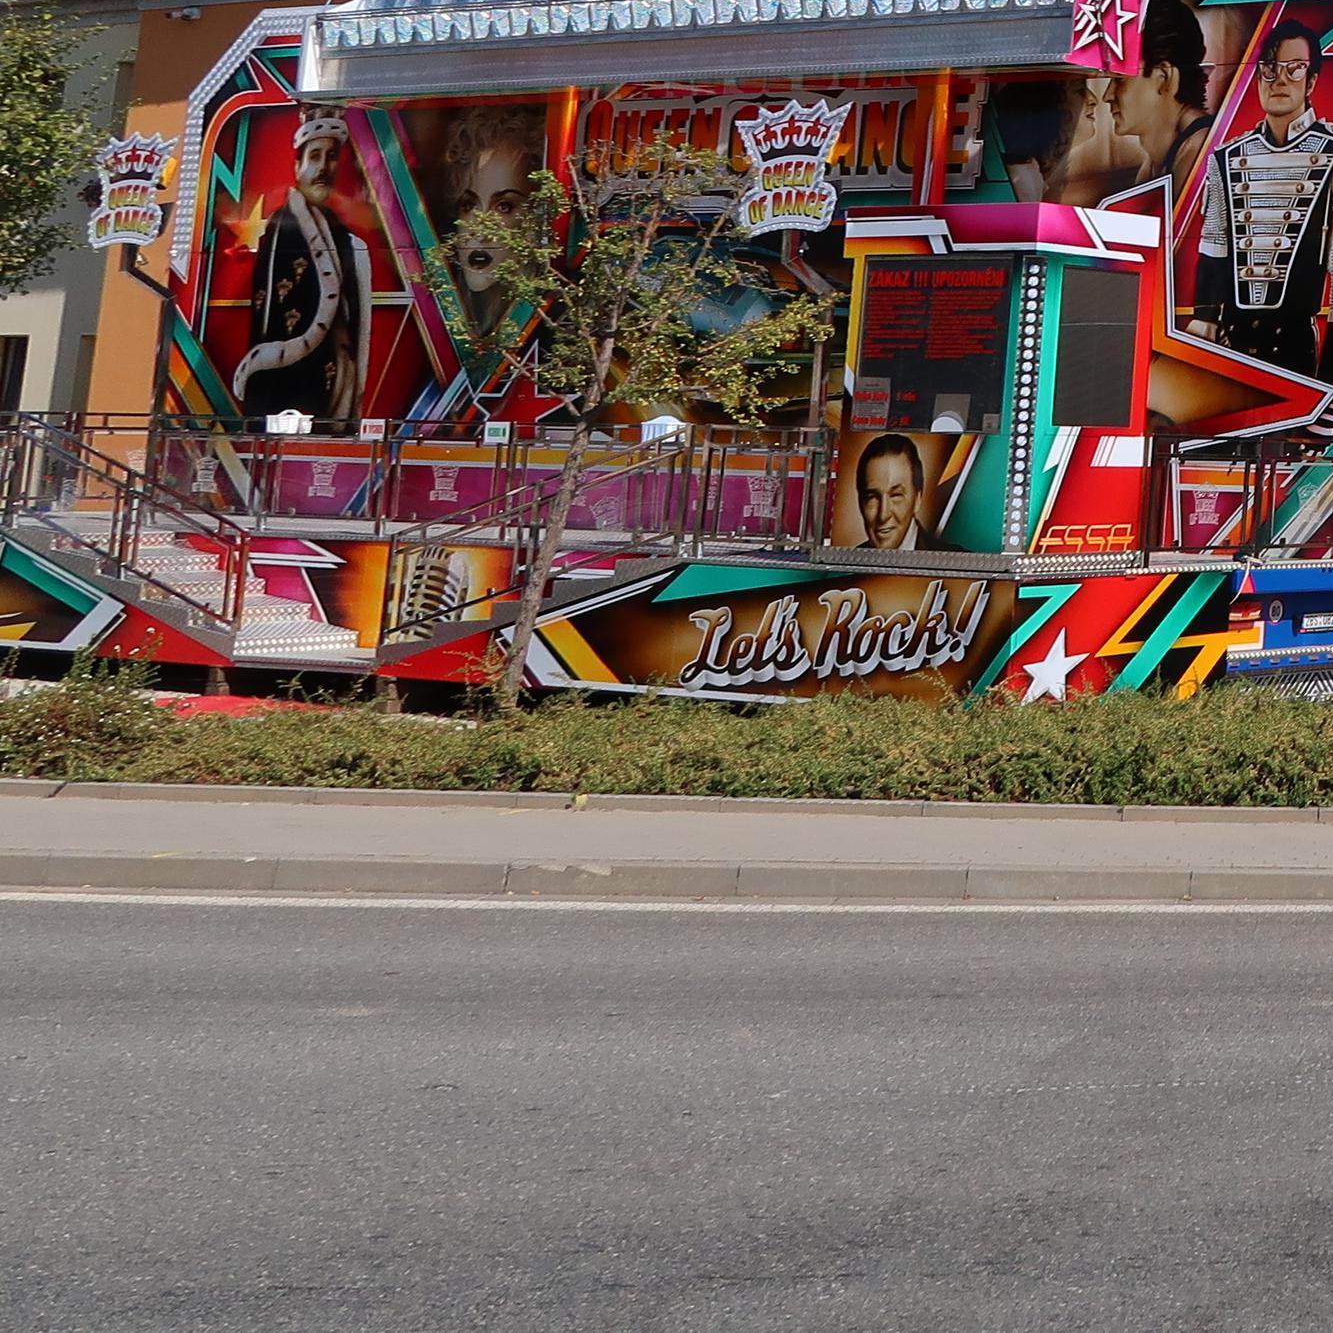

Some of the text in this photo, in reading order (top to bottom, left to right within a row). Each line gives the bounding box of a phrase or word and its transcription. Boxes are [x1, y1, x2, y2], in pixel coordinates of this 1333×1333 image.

[763, 161, 816, 191] QUEEN
[748, 190, 828, 225] OF DANCE
[679, 578, 991, 689] Let's Rock!
